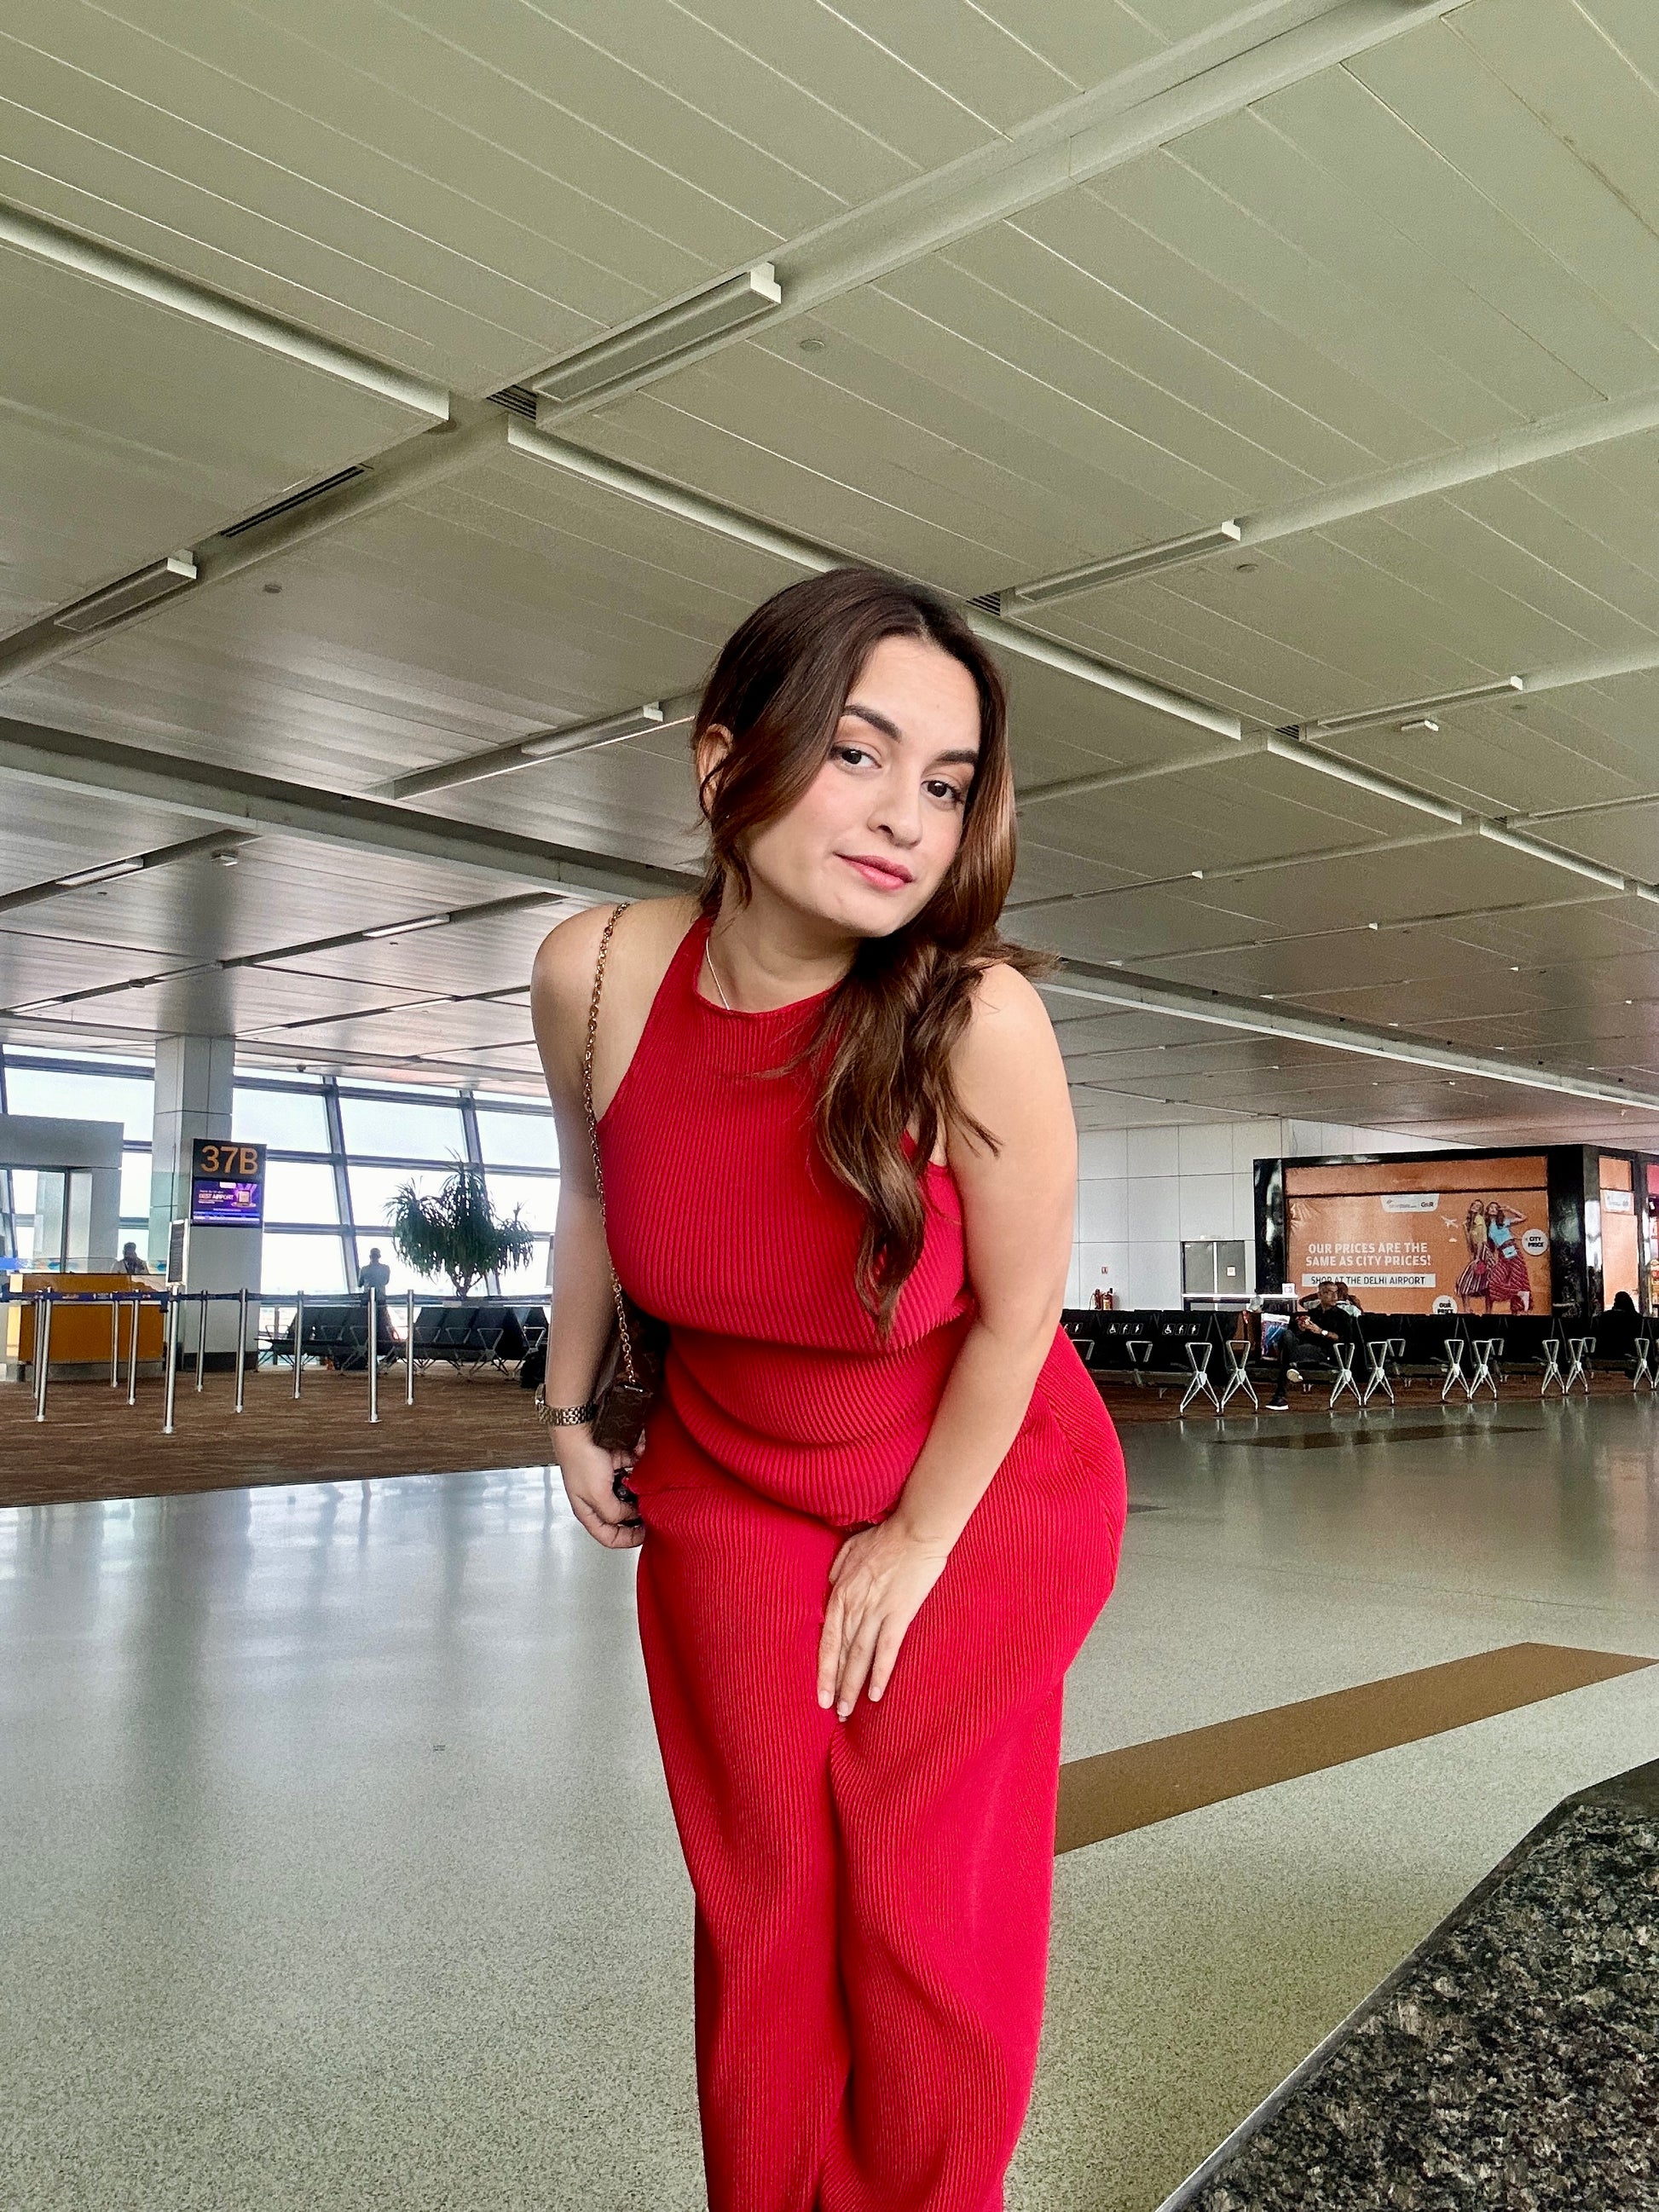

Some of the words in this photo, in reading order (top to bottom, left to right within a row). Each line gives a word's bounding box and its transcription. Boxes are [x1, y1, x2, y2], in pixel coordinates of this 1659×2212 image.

[200, 1145, 258, 1174] 37B
[1308, 1243, 1332, 1254] OUR
[1334, 1243, 1375, 1253] PRICES
[1378, 1242, 1402, 1253] ARE
[1403, 1242, 1428, 1253] THE
[1305, 1256, 1336, 1266] SAME
[1338, 1256, 1353, 1266] AS
[1356, 1256, 1382, 1266] CITY
[1384, 1255, 1431, 1266] PRICES!
[1389, 1276, 1425, 1285] AIRPORT
